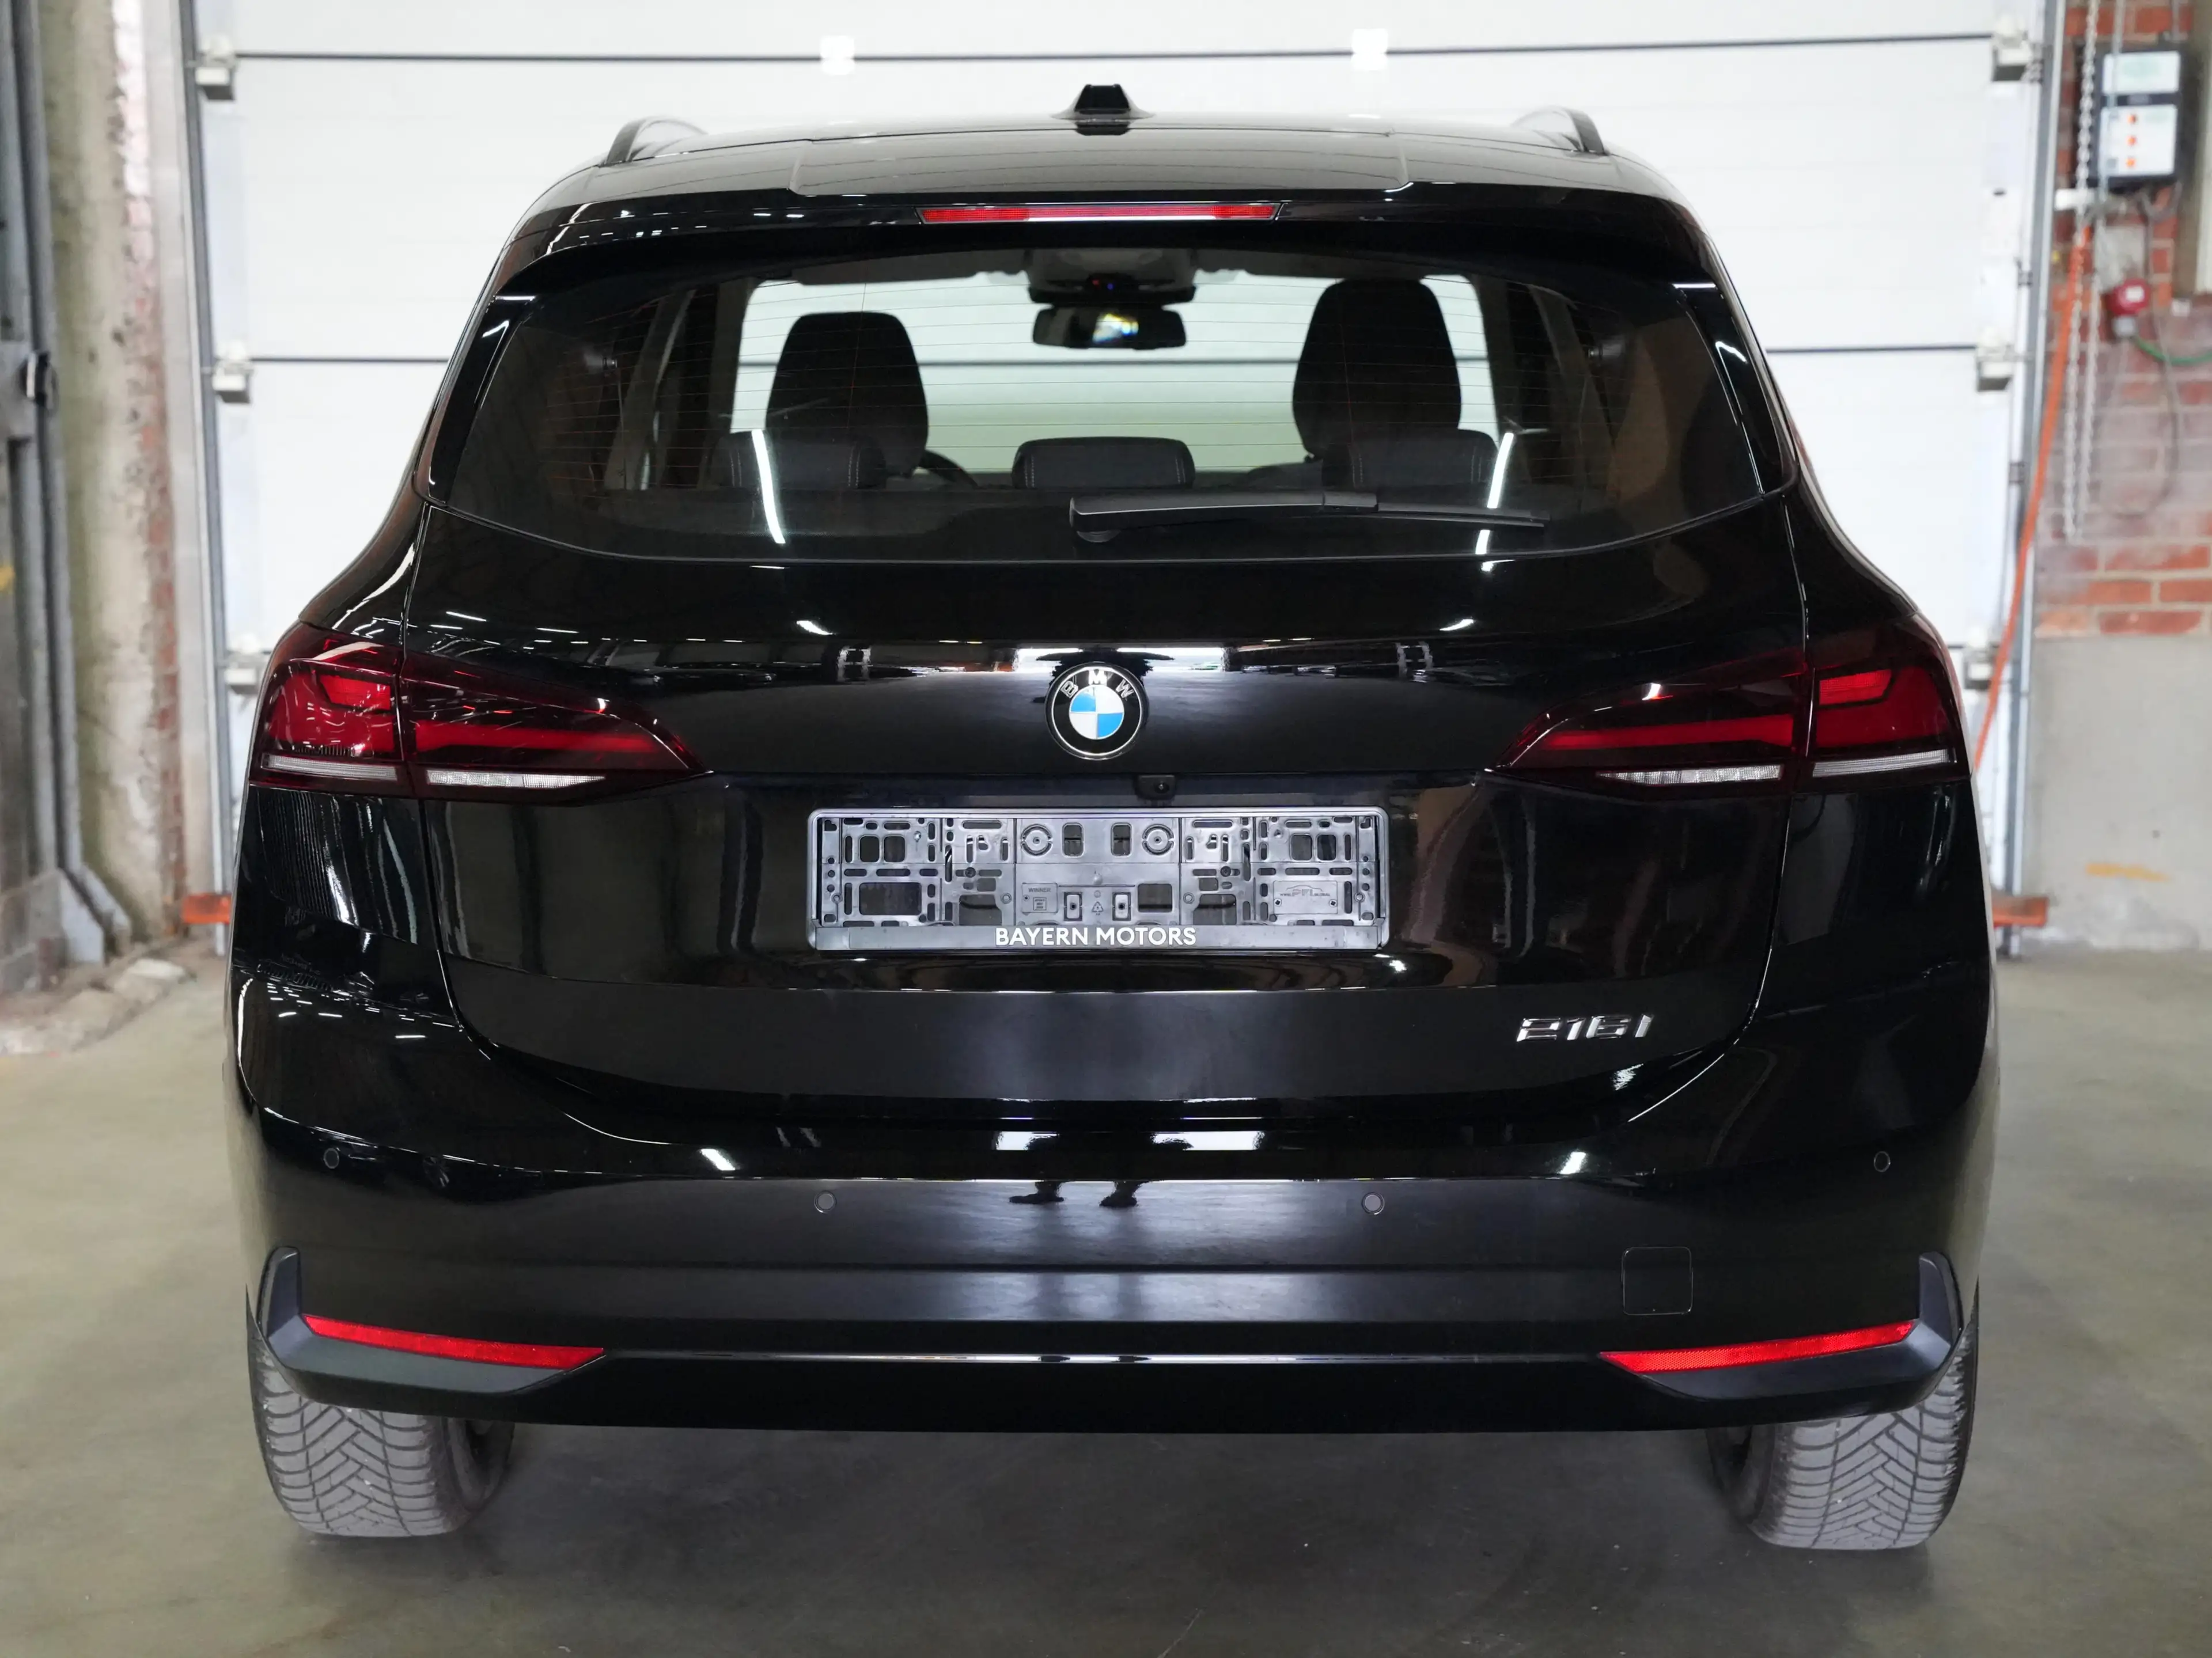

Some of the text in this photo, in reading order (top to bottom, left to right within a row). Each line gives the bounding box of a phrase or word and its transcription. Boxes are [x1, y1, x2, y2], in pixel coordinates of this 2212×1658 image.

[1060, 669, 1134, 699] BMW
[995, 927, 1196, 946] BAYERN MOTORS
